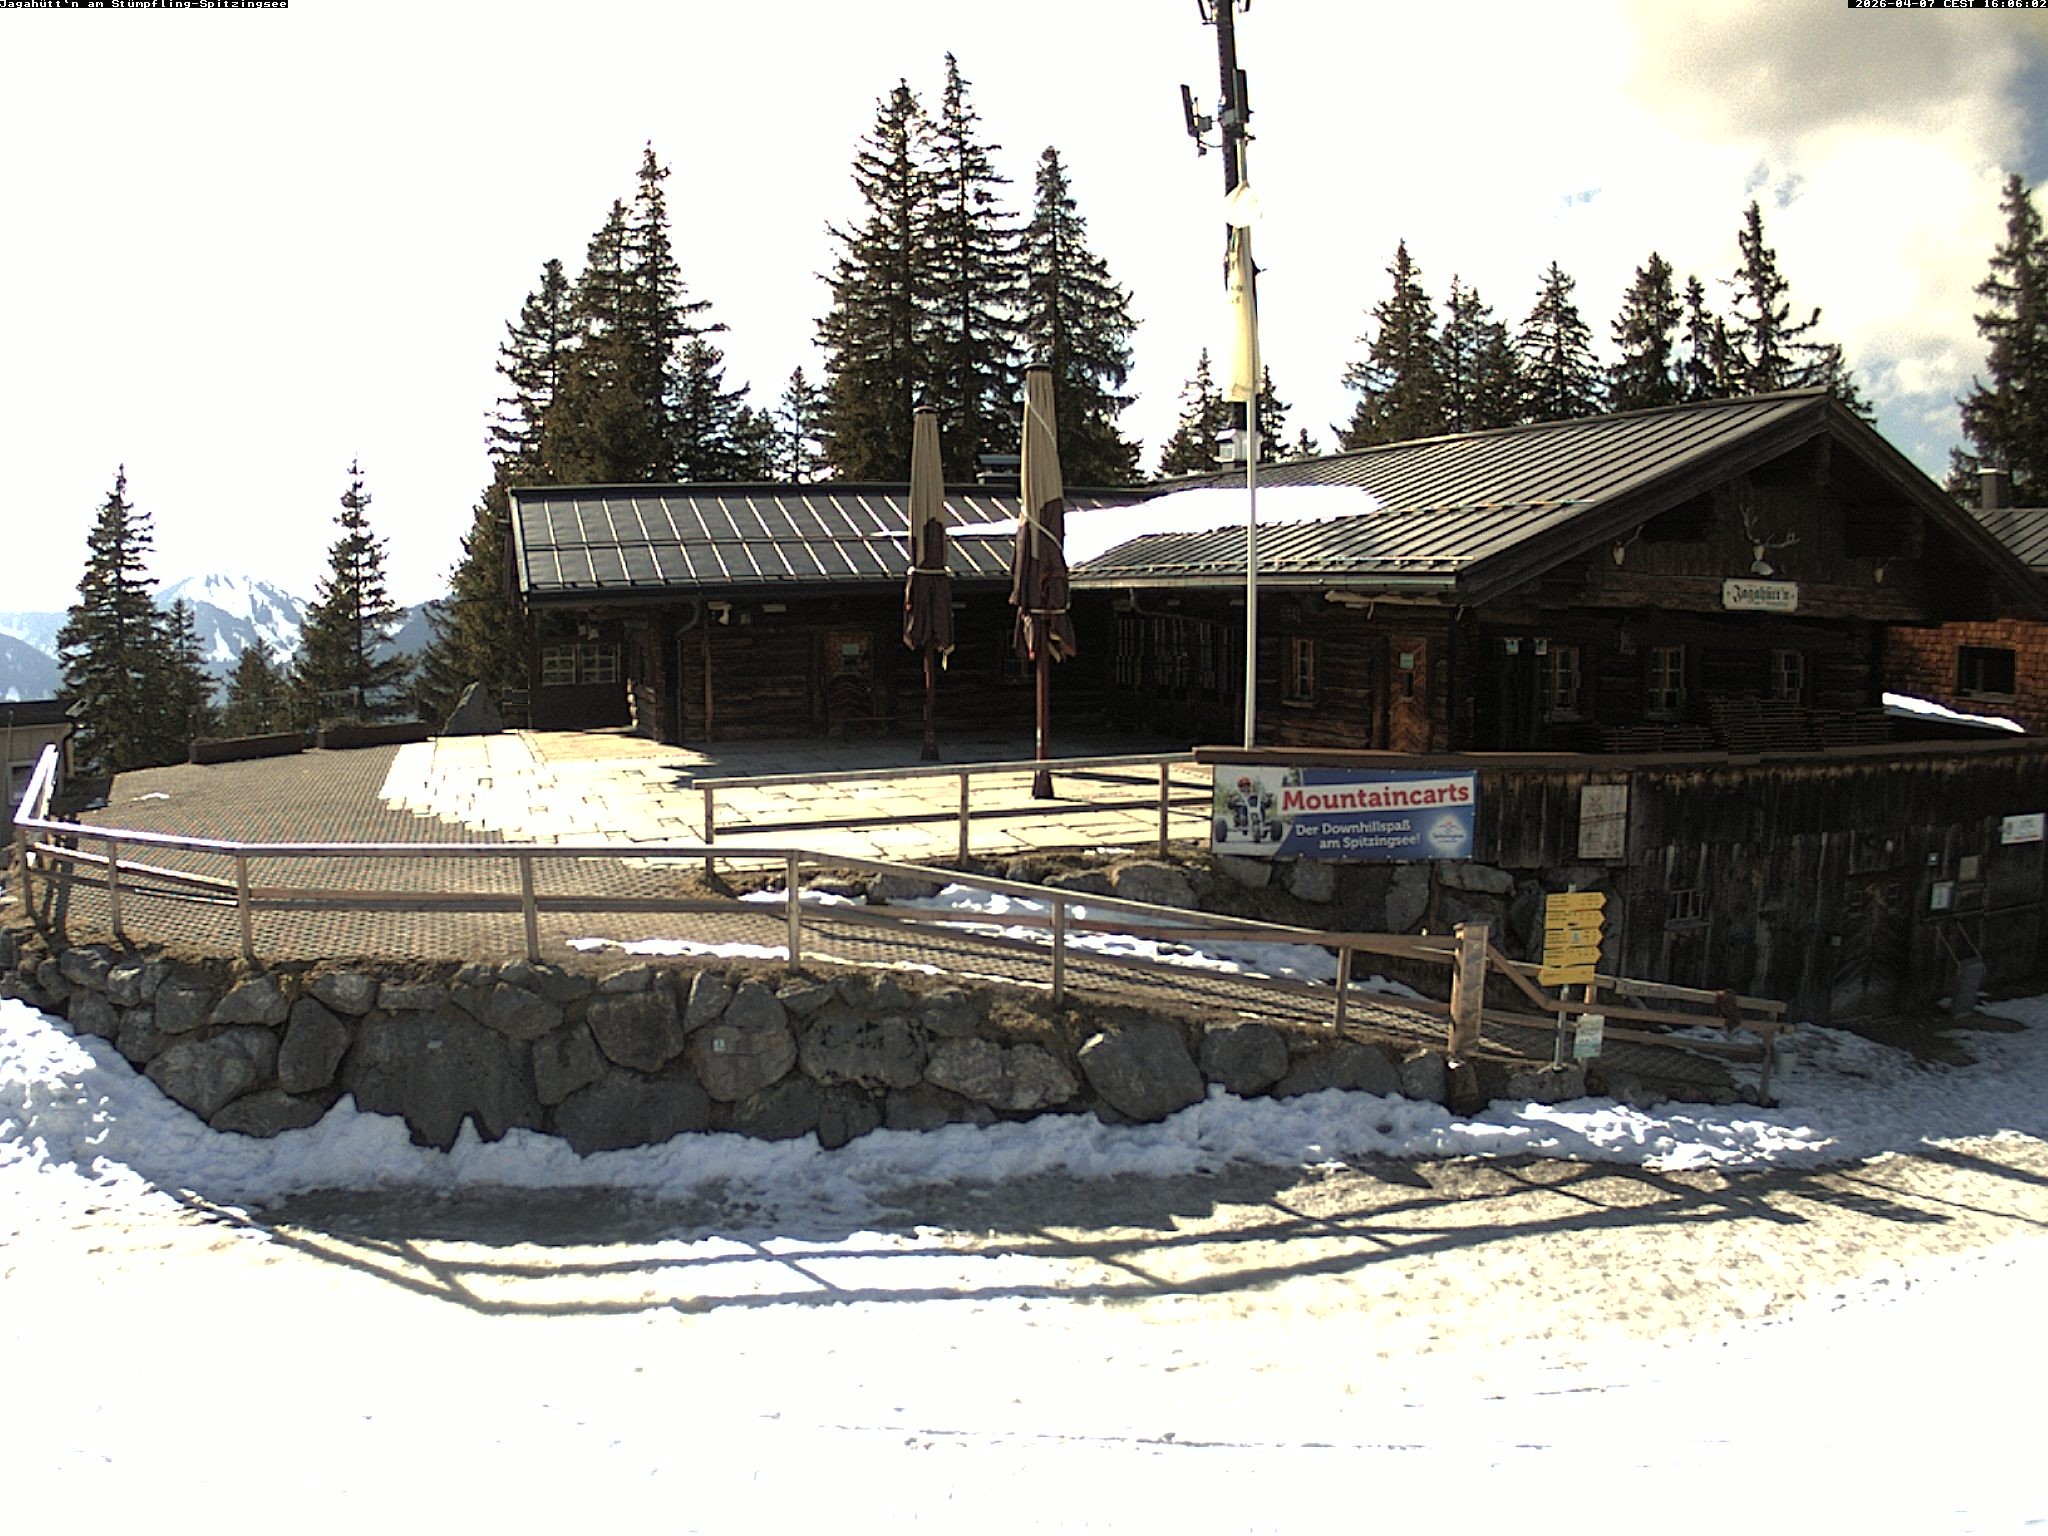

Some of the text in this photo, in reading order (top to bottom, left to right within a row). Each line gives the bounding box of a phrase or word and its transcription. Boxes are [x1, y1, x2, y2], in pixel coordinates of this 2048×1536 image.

[1281, 783, 1470, 812] Mountaincarts
[1296, 819, 1411, 837] Der Downhillspaß
[1319, 838, 1340, 849] am
